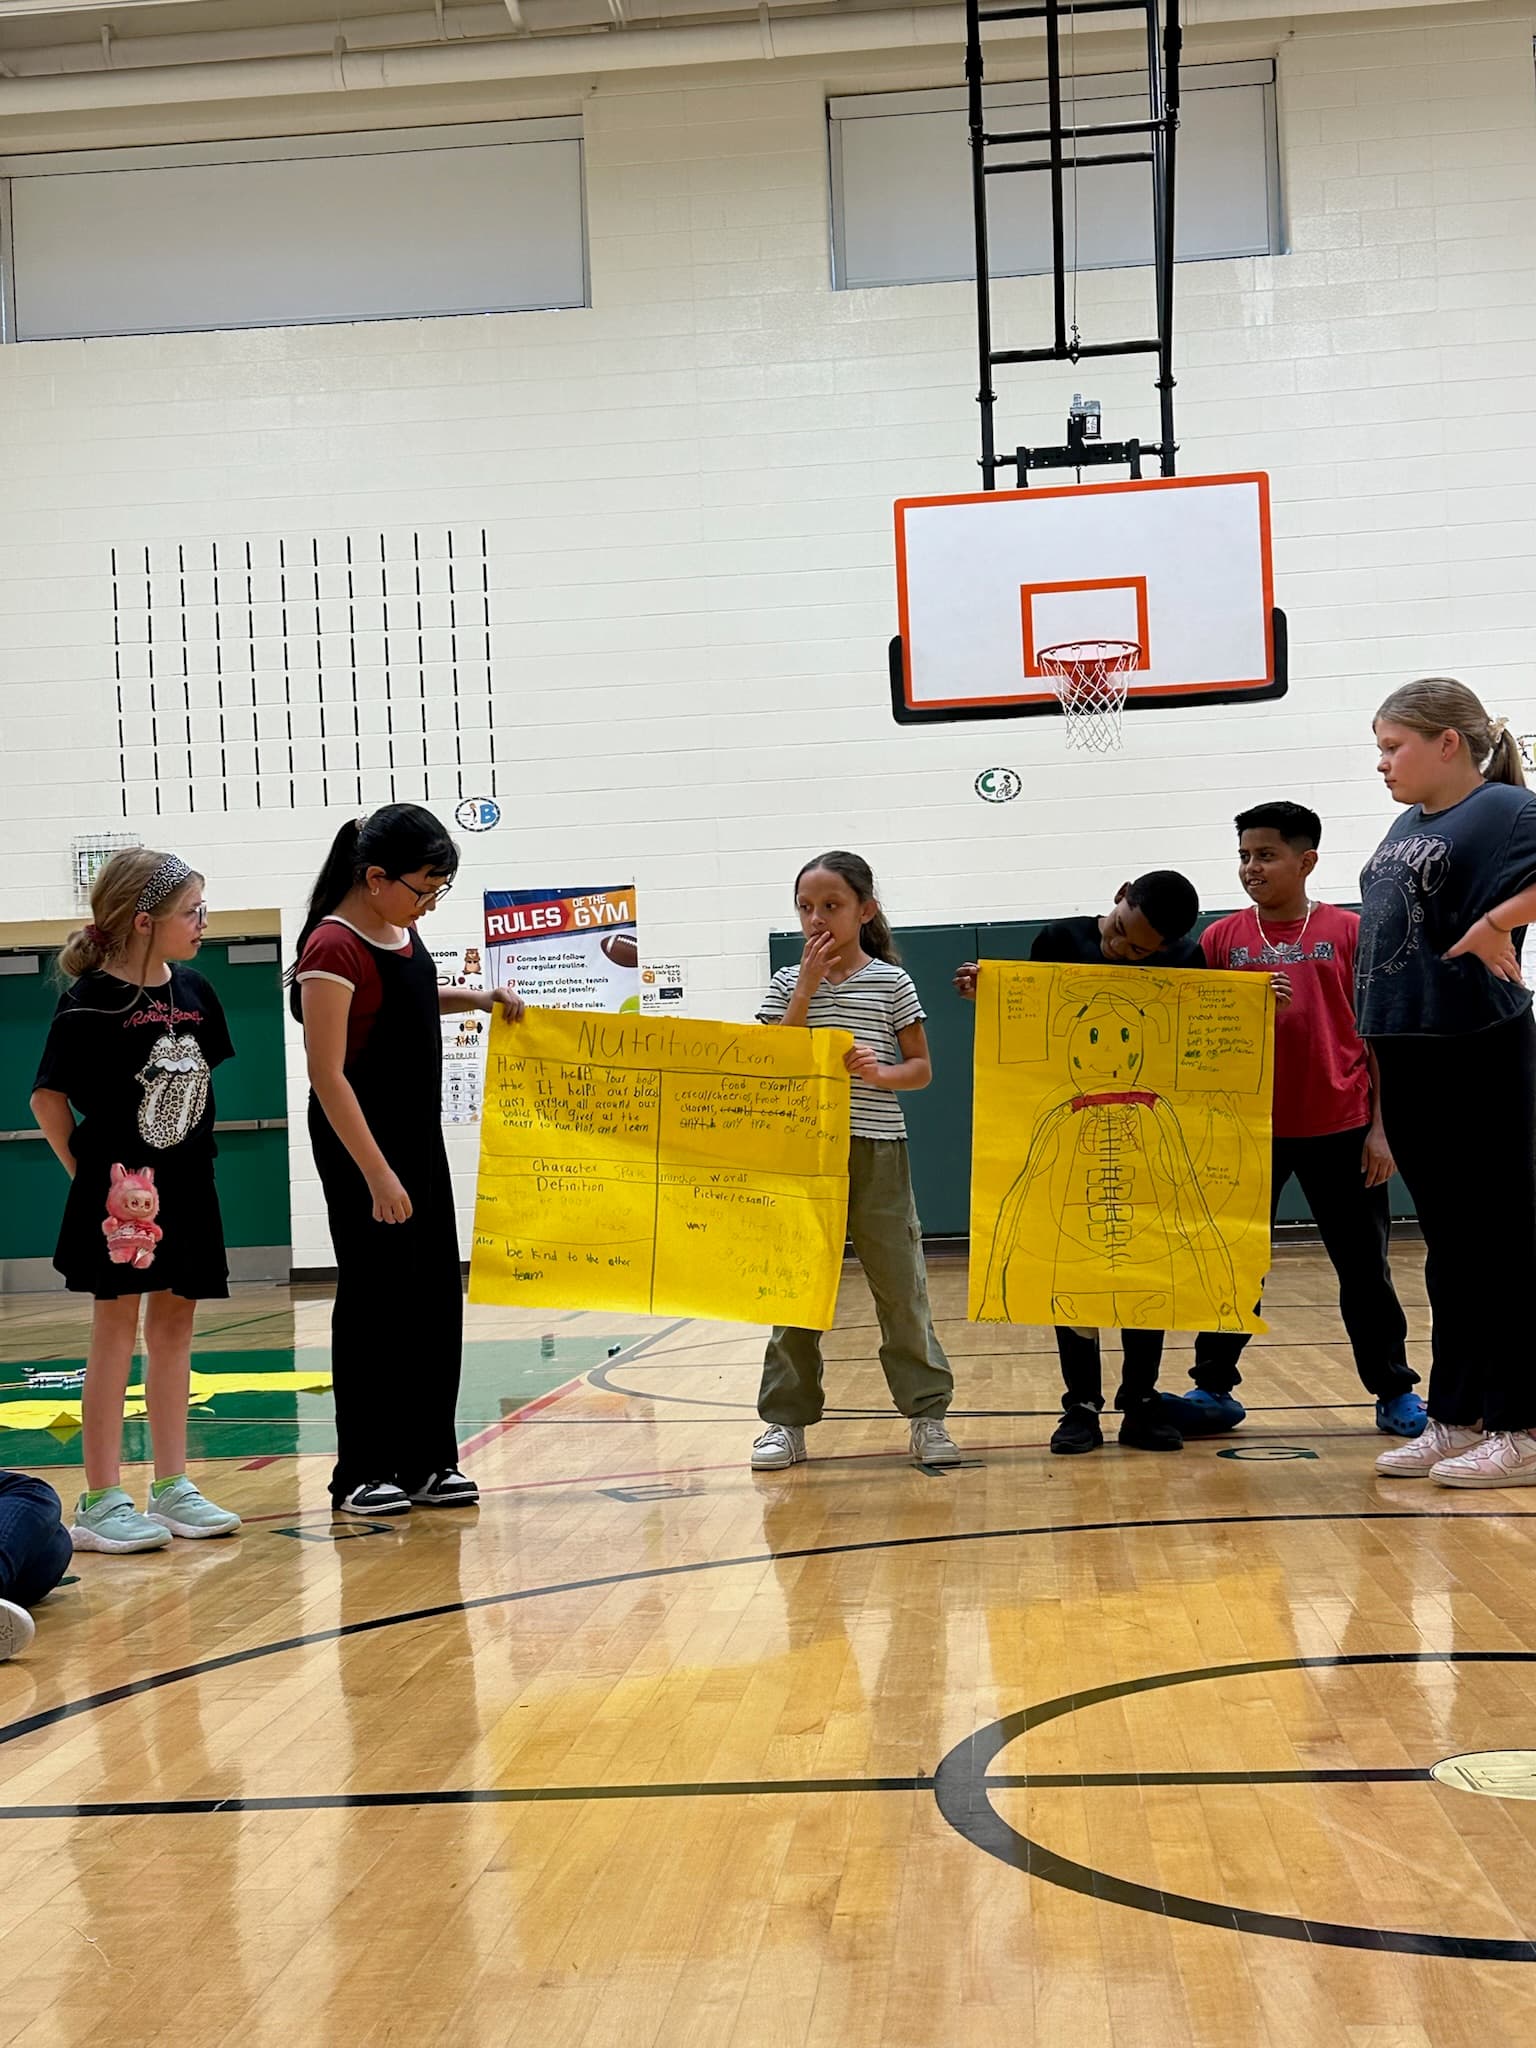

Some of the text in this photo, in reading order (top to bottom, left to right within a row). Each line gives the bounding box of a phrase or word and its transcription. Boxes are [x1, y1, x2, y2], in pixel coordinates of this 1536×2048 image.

[981, 772, 996, 793] C
[479, 803, 496, 824] B
[572, 894, 607, 909] OF THE
[487, 906, 562, 936] RULES
[574, 901, 629, 927] GYM
[516, 955, 537, 963] Come
[531, 963, 557, 971] regular
[517, 979, 536, 987] Wear
[537, 979, 554, 987] gym
[568, 986, 597, 994] jewelry.
[498, 1056, 526, 1074] How
[535, 1061, 548, 1076] it
[536, 1079, 554, 1095] It
[608, 1086, 628, 1097] our
[720, 1077, 746, 1091] food
[576, 1098, 588, 1110] all
[595, 1100, 630, 1109] around
[621, 1111, 640, 1121] the
[799, 1116, 817, 1126] and
[598, 1125, 617, 1134] and
[624, 1123, 649, 1132] learn
[532, 1159, 597, 1174] Character
[536, 1175, 604, 1192] Definition
[505, 1239, 524, 1259] be
[567, 1251, 578, 1262] to
[585, 1253, 600, 1264] the
